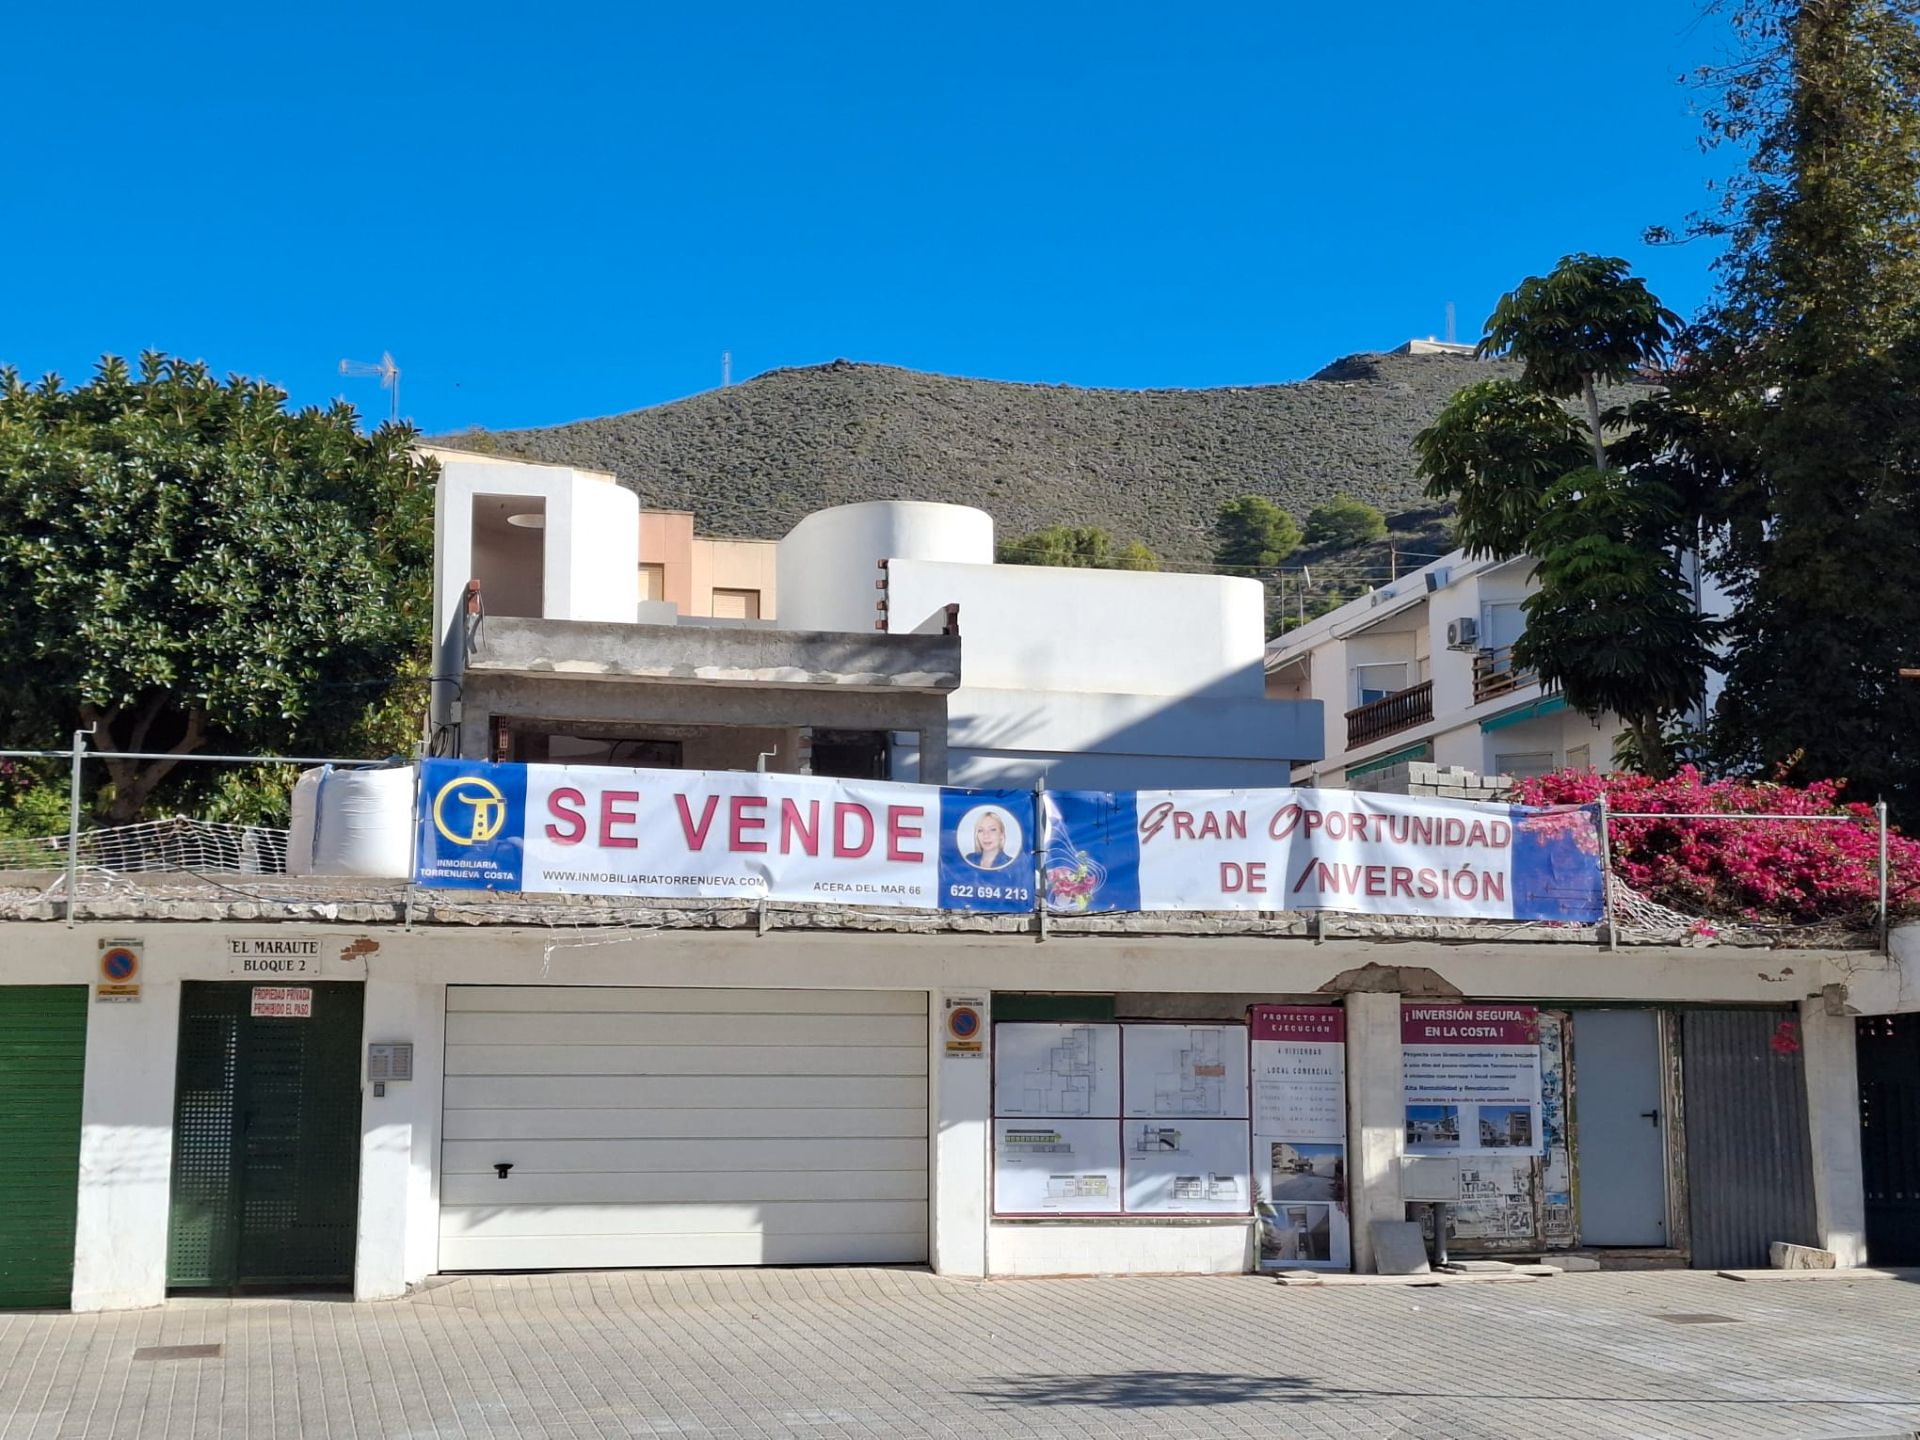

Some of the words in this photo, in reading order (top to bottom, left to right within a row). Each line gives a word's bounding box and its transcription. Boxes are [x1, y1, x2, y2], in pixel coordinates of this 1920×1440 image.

[545, 787, 640, 848] SE
[673, 794, 925, 863] VENDE
[1139, 801, 1247, 845] GRAN
[1268, 803, 1511, 849] OPORTUNIDAD
[437, 859, 498, 869] INMOBILIARIA
[421, 868, 480, 878] TORRENUEVA
[484, 871, 514, 880] COSTA
[542, 871, 765, 887] WWW.INMOBILIARIATORRENUEVA.COM
[1220, 862, 1267, 893] DE
[1293, 857, 1505, 902] INVERSIÓN
[813, 882, 852, 892] ACERA
[855, 884, 875, 893] DEL
[881, 885, 906, 894] MAR
[909, 886, 921, 895] 66
[950, 885, 974, 897] 622
[977, 887, 1001, 898] 694
[1005, 888, 1028, 900] 213
[233, 941, 249, 953] EL
[255, 941, 319, 954] MARAUTE
[244, 960, 294, 972] BLOQUE
[298, 960, 306, 971] 2
[1262, 1013, 1316, 1022] PROYECTO
[1412, 1008, 1473, 1021] INVERSIÓN
[1425, 1027, 1440, 1037] EN
[1443, 1027, 1458, 1037] LA
[1460, 1027, 1498, 1037] COSTA
